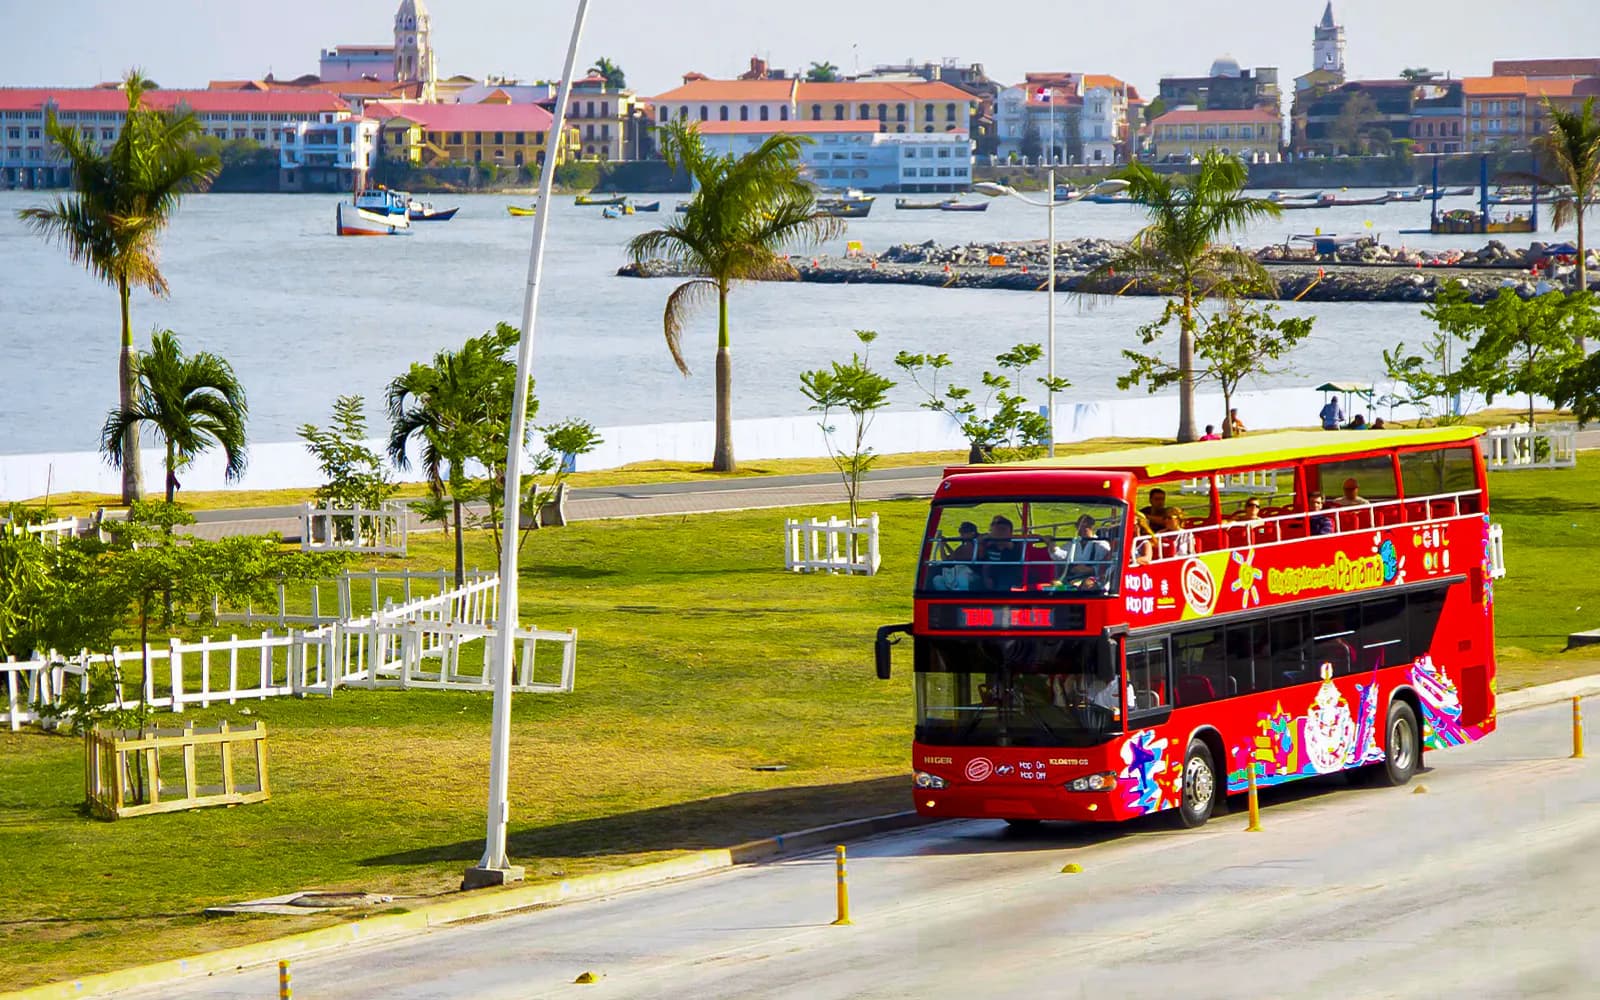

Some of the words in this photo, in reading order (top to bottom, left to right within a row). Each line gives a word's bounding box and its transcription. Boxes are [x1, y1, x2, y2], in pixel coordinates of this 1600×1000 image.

[1335, 550, 1384, 591] Panama
[1125, 574, 1141, 592] Hop
[1142, 572, 1153, 592] On
[1126, 596, 1142, 614] Hop
[1142, 596, 1154, 615] Off
[924, 756, 953, 765] HIGER
[1019, 761, 1033, 770] Hop
[1035, 760, 1046, 769] On
[1020, 771, 1034, 780] Hop
[1035, 771, 1047, 780] Off
